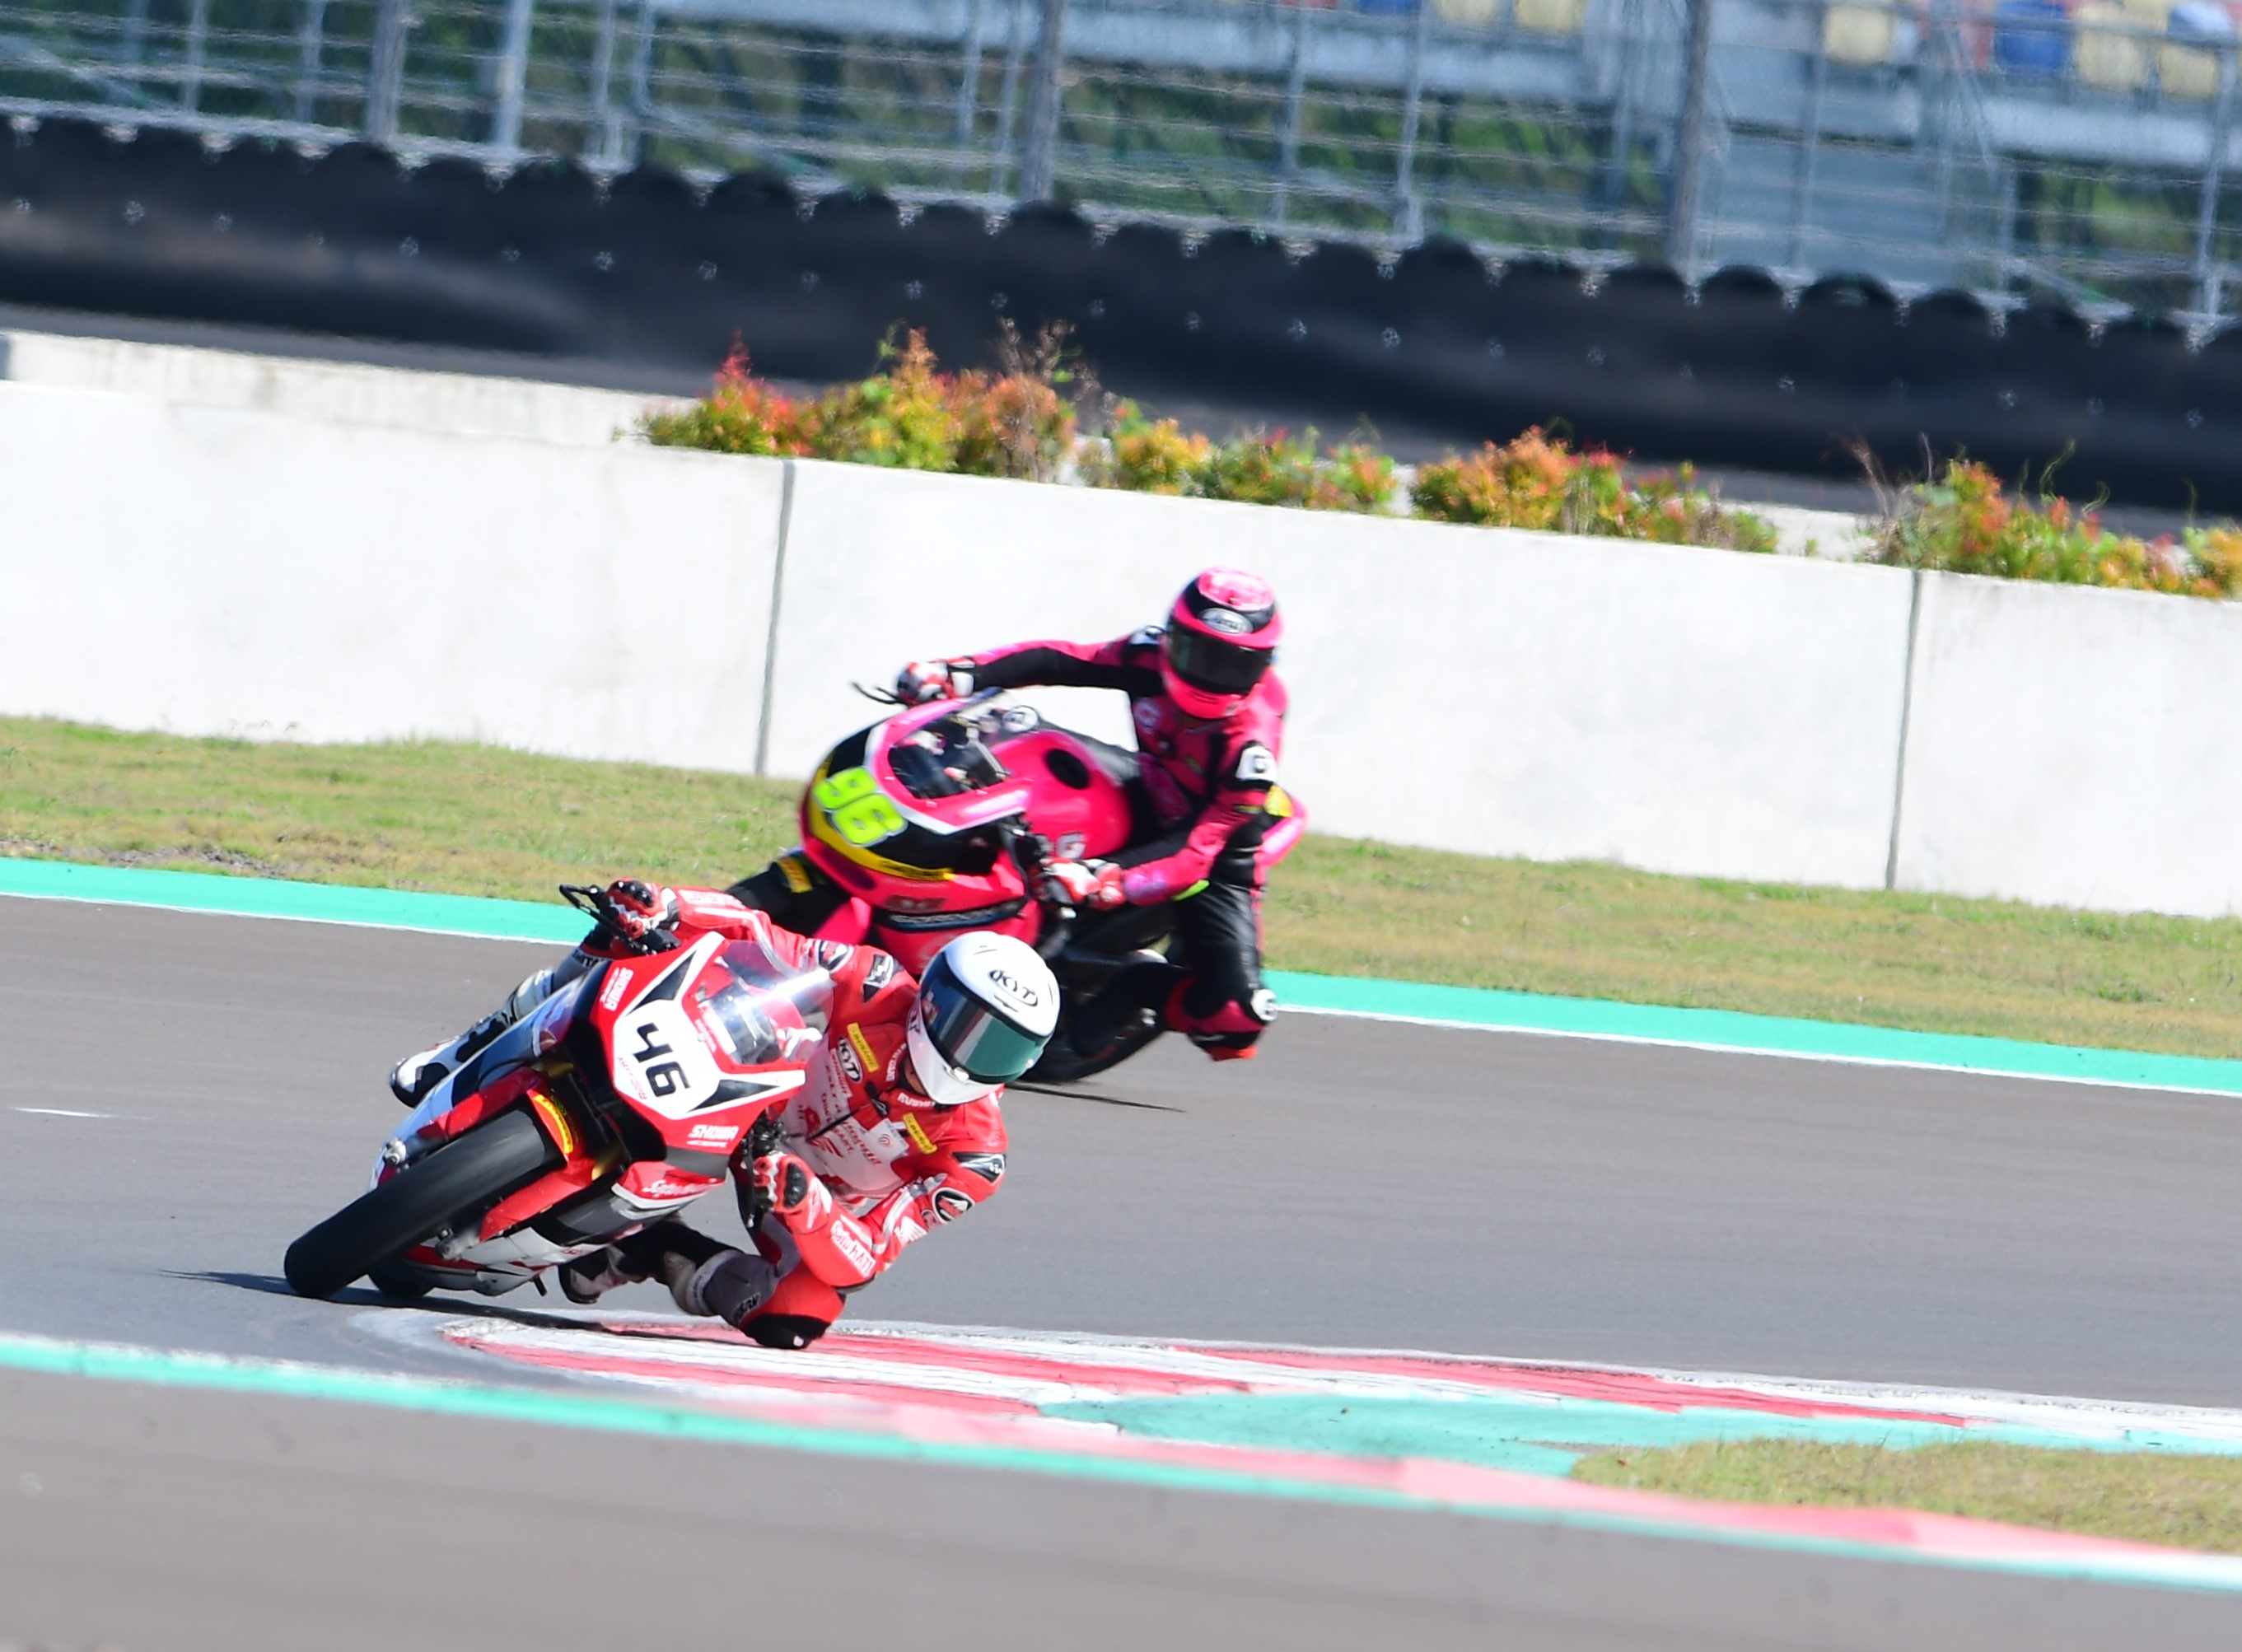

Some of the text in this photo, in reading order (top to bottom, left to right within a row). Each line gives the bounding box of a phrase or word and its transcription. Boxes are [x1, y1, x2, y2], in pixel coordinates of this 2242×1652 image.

[812, 763, 908, 847] 96
[991, 969, 1038, 1006] KYT
[633, 1022, 690, 1097] 46
[838, 1037, 862, 1082] KYT
[688, 1124, 740, 1141] SHOWA
